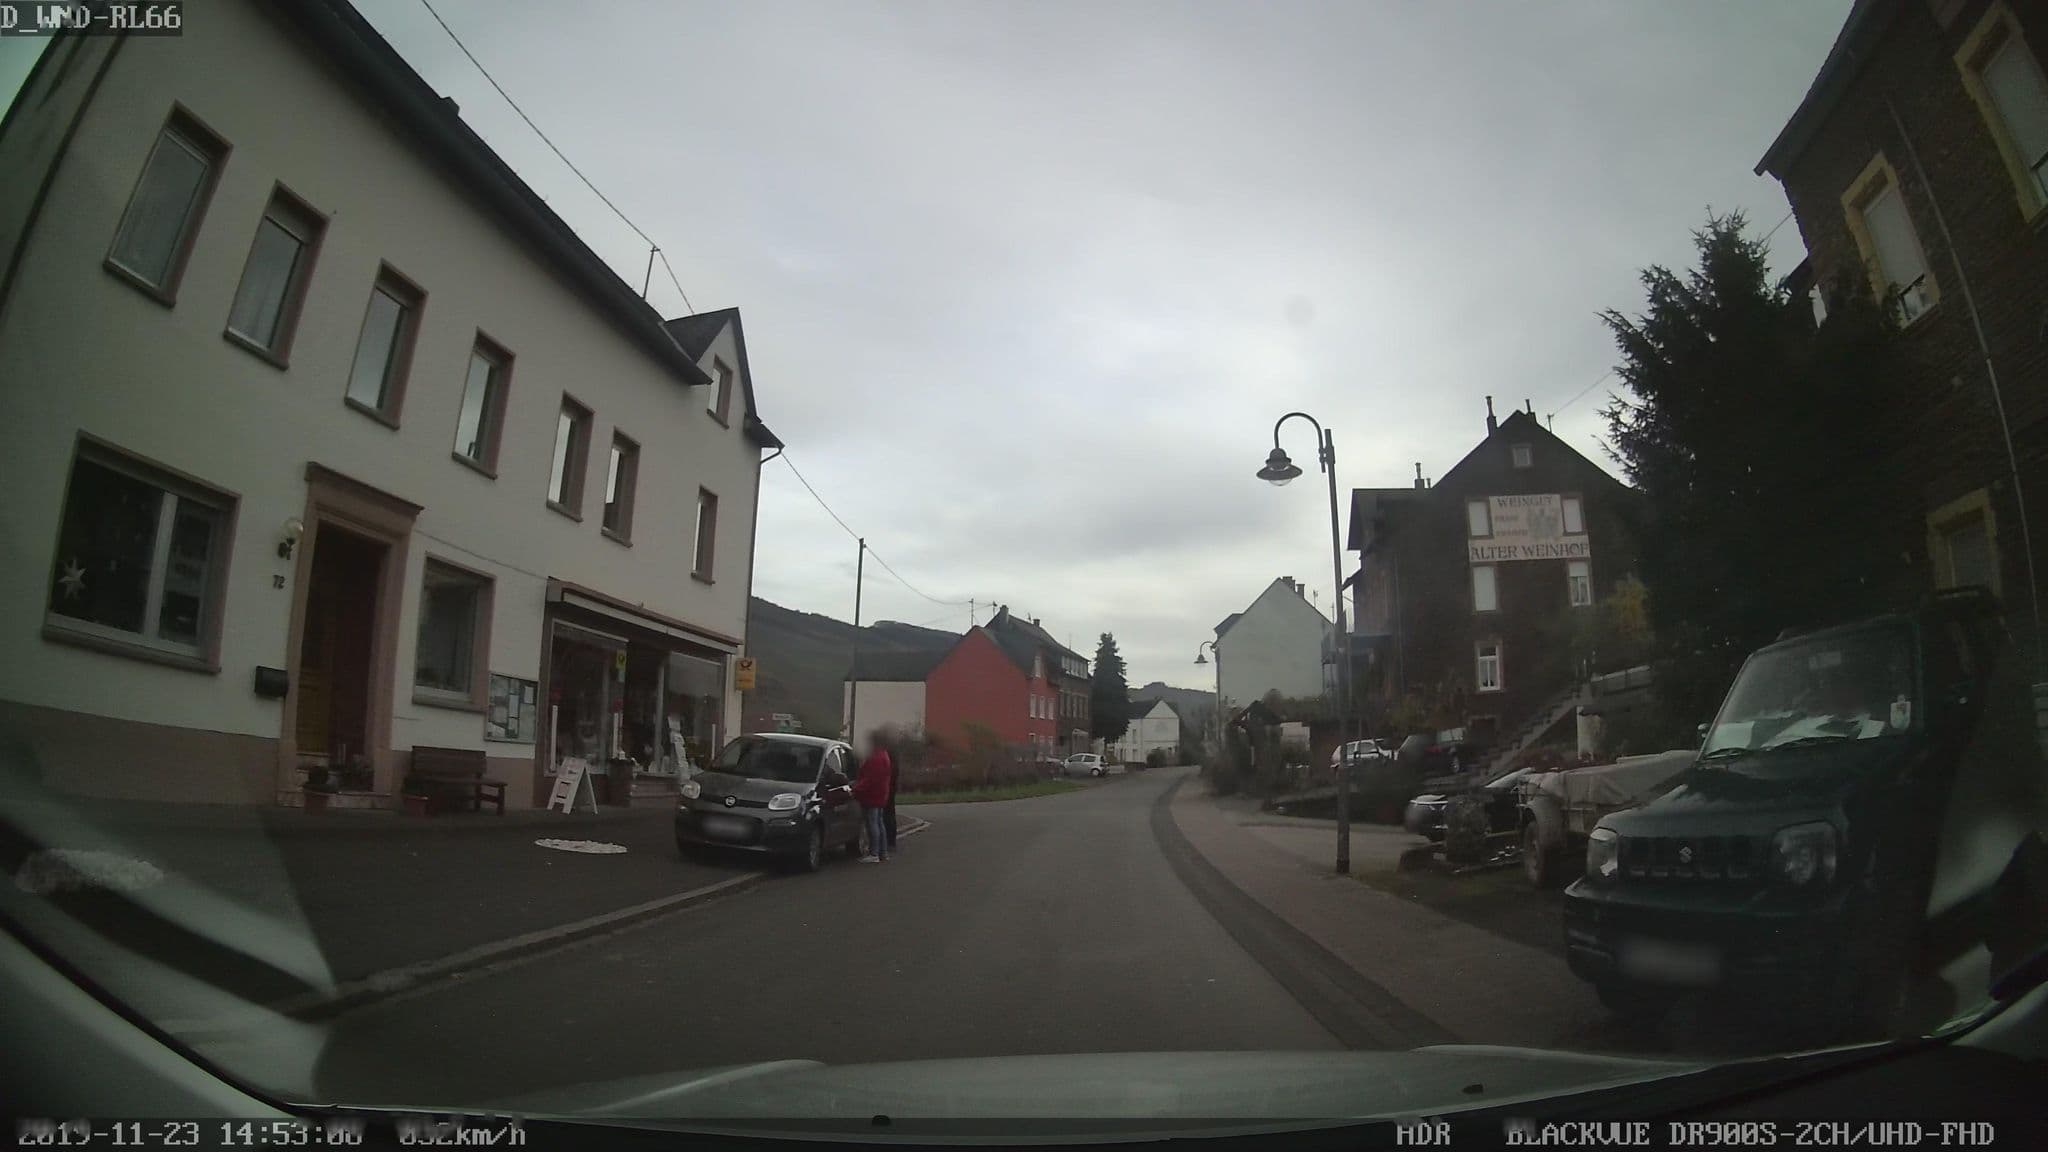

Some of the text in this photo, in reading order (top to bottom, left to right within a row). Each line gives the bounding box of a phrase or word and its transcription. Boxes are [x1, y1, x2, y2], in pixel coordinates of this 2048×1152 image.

[1470, 543, 1589, 561] ALTER WEINHOF
[272, 574, 286, 590] 72
